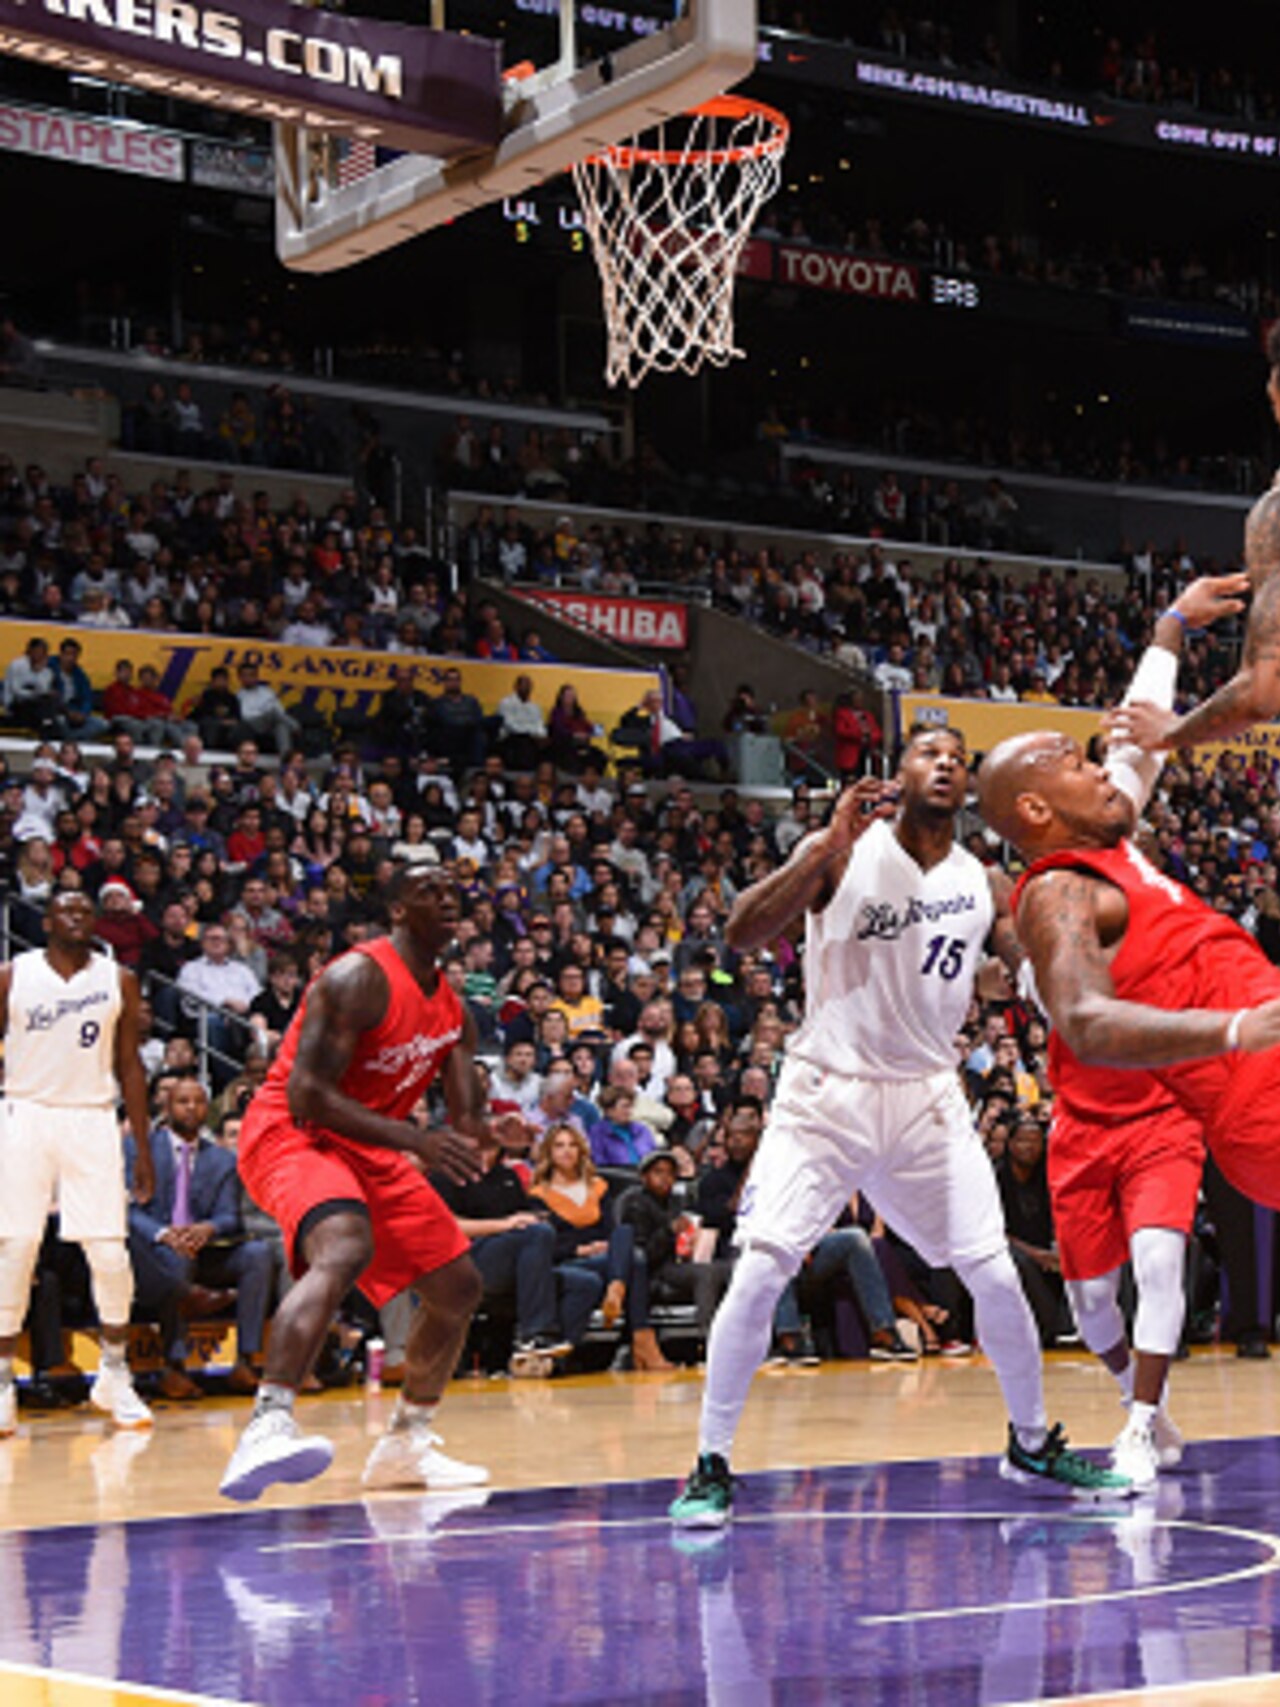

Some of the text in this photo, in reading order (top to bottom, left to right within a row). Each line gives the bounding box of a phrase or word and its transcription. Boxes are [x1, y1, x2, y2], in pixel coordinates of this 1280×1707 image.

[0, 108, 176, 175] STAPLES
[779, 250, 917, 299] TOYOTA
[921, 934, 967, 980] 15
[79, 1019, 101, 1049] 9
